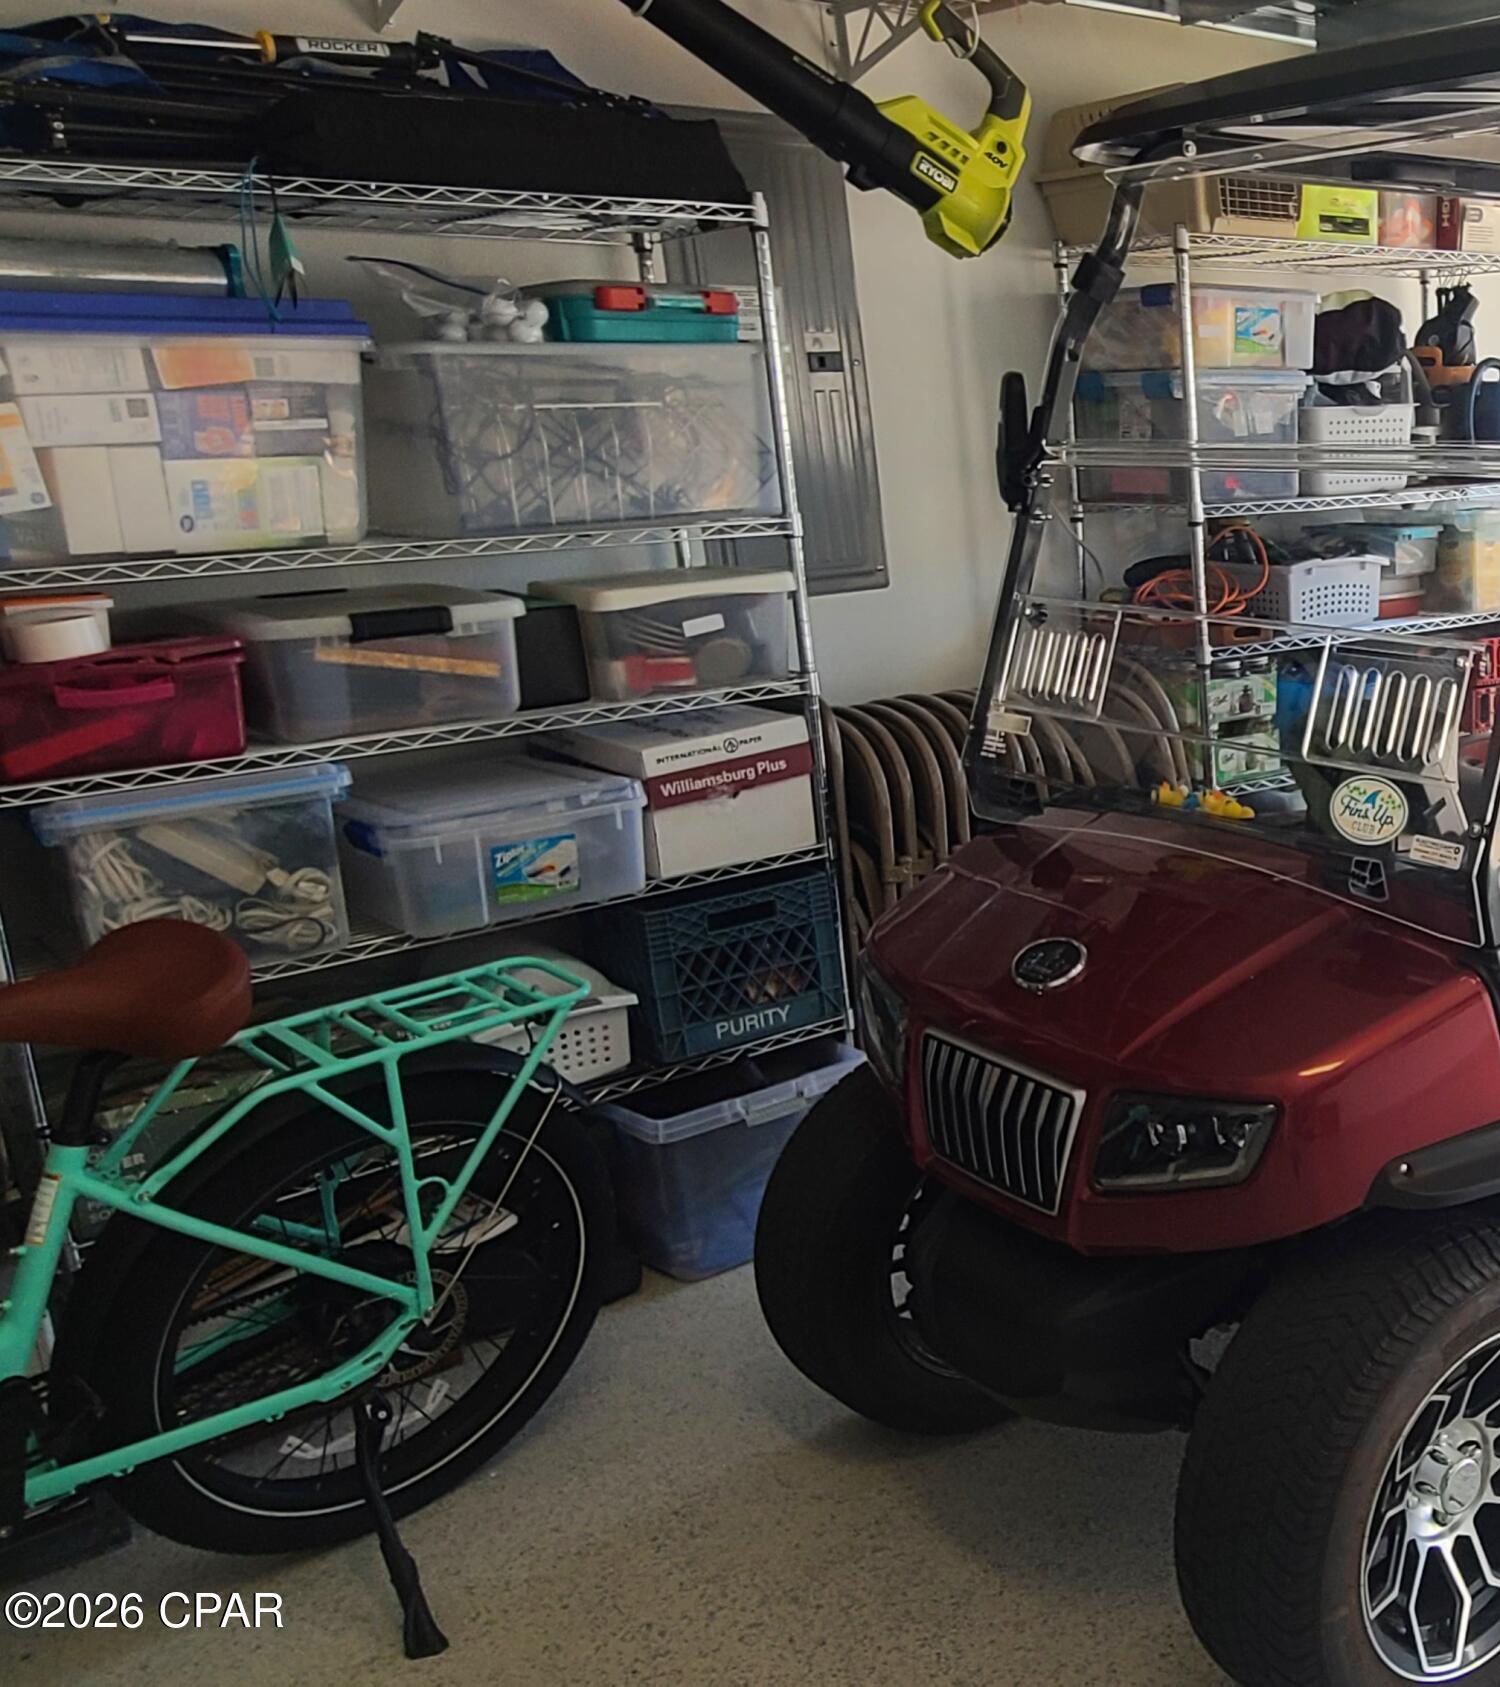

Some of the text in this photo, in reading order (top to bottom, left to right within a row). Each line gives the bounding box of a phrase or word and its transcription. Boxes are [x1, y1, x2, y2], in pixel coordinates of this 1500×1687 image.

[308, 41, 378, 52] ROCKER
[919, 158, 956, 190] RYOBI
[984, 152, 1008, 168] 40V
[656, 736, 762, 764] INTERNATIONAL PAPER
[660, 758, 787, 797] Williamsburg Plus
[1340, 794, 1370, 819] Fins
[716, 1004, 790, 1040] PURITY
